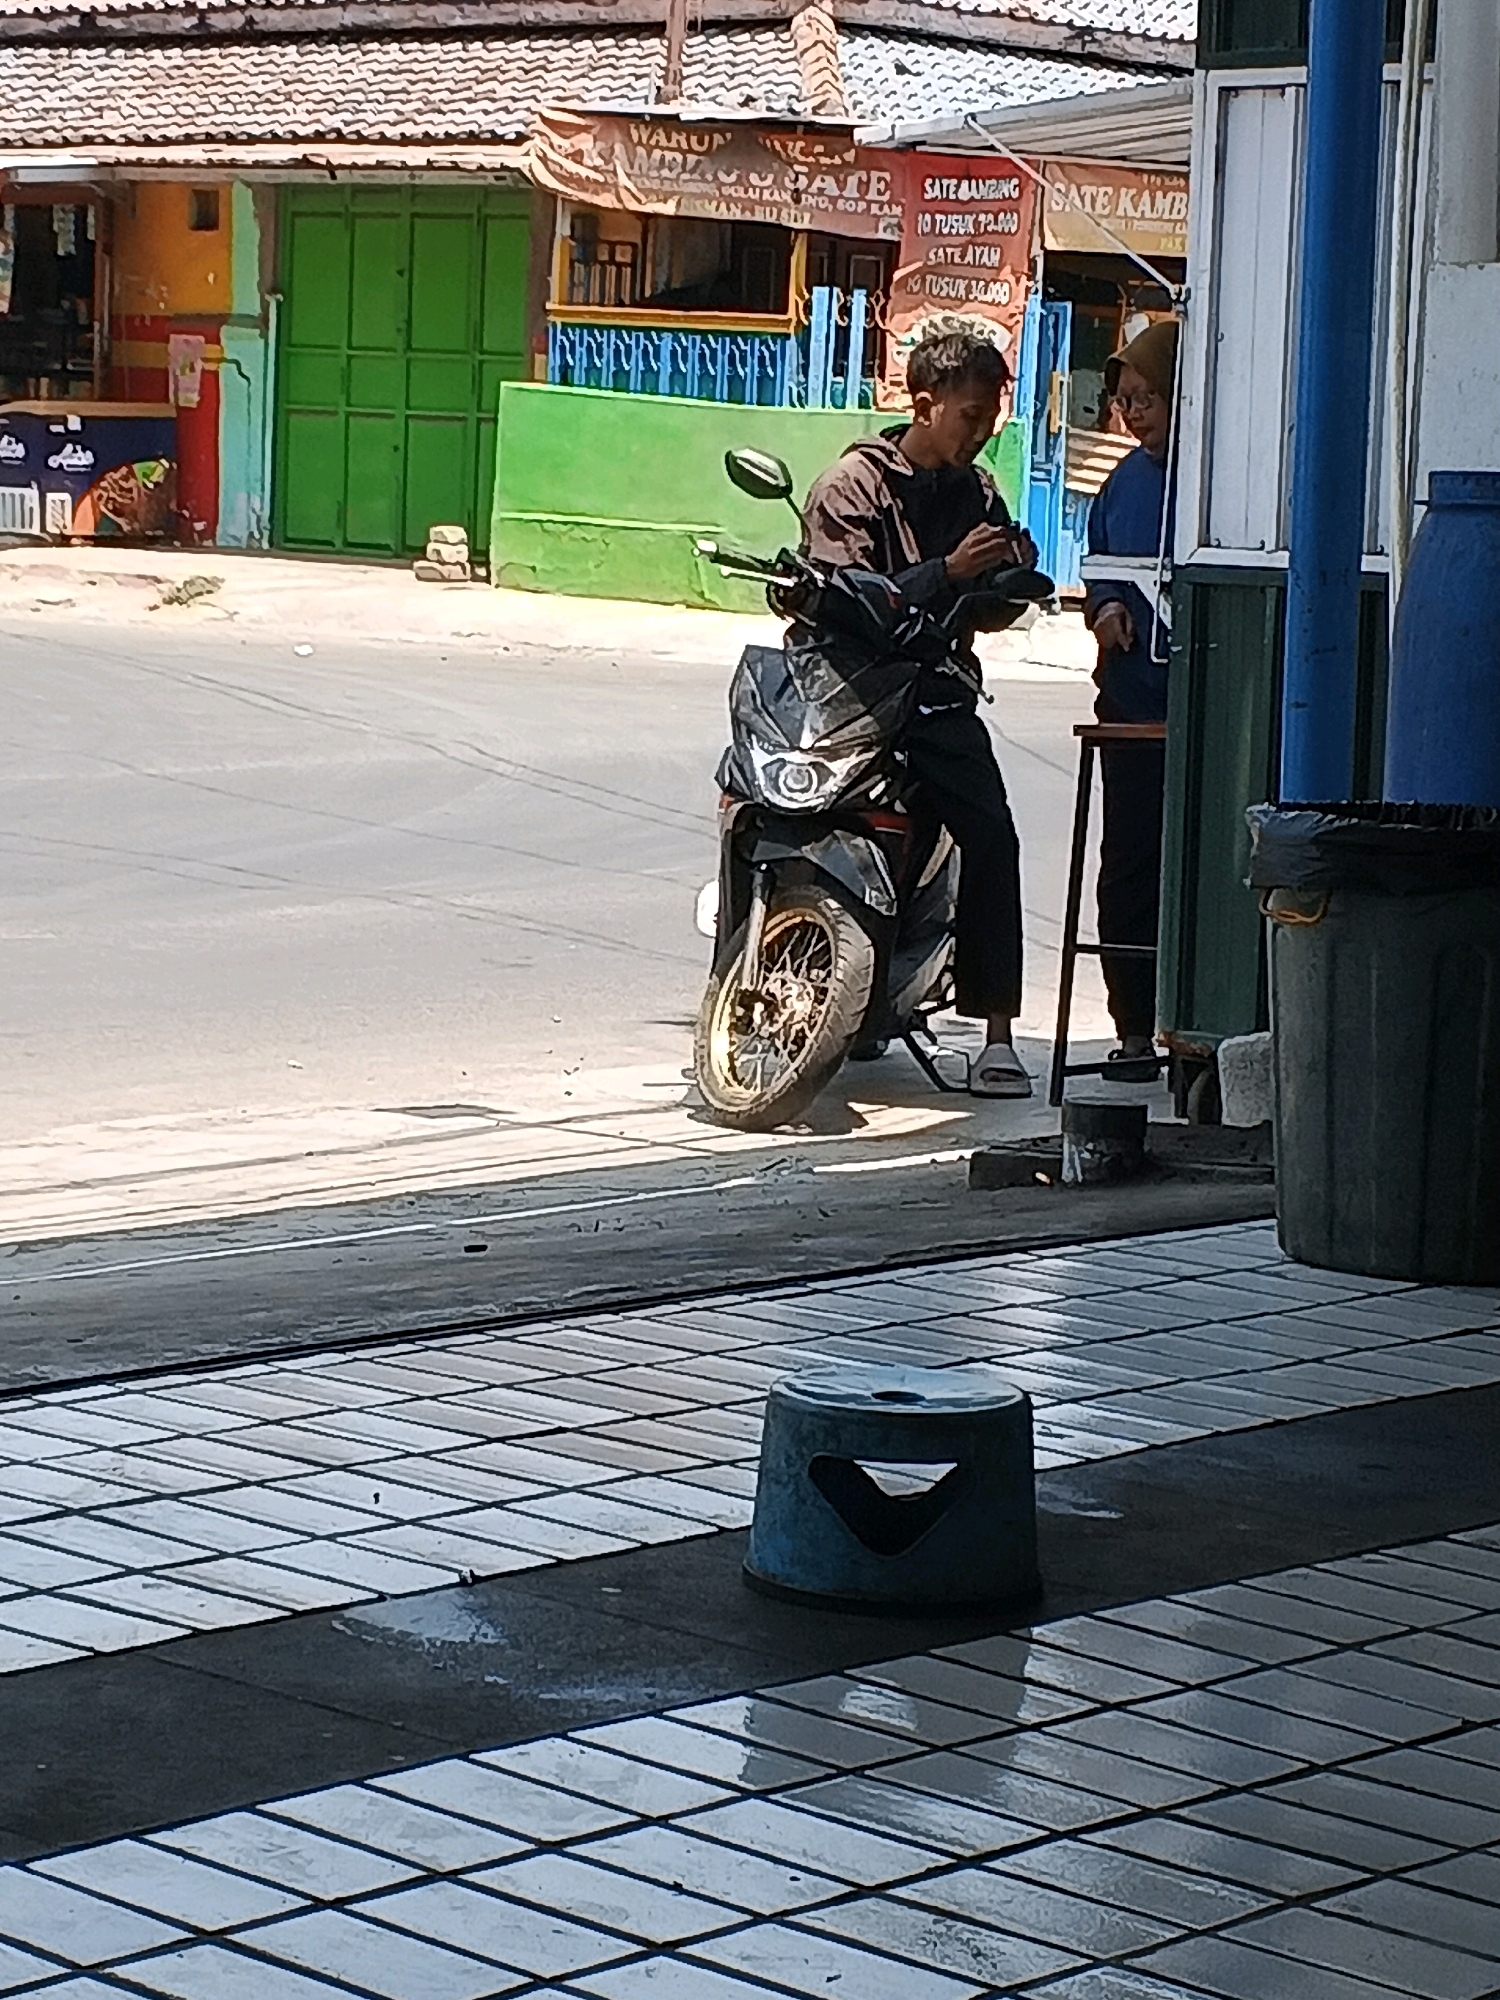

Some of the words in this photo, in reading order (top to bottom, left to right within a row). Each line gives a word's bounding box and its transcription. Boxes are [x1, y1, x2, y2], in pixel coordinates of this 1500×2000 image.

[784, 166, 891, 202] SATE
[924, 178, 957, 199] SATE
[1051, 182, 1114, 215] SATE
[917, 213, 932, 234] 10
[935, 213, 976, 235] TUSUK
[926, 247, 962, 266] SATE
